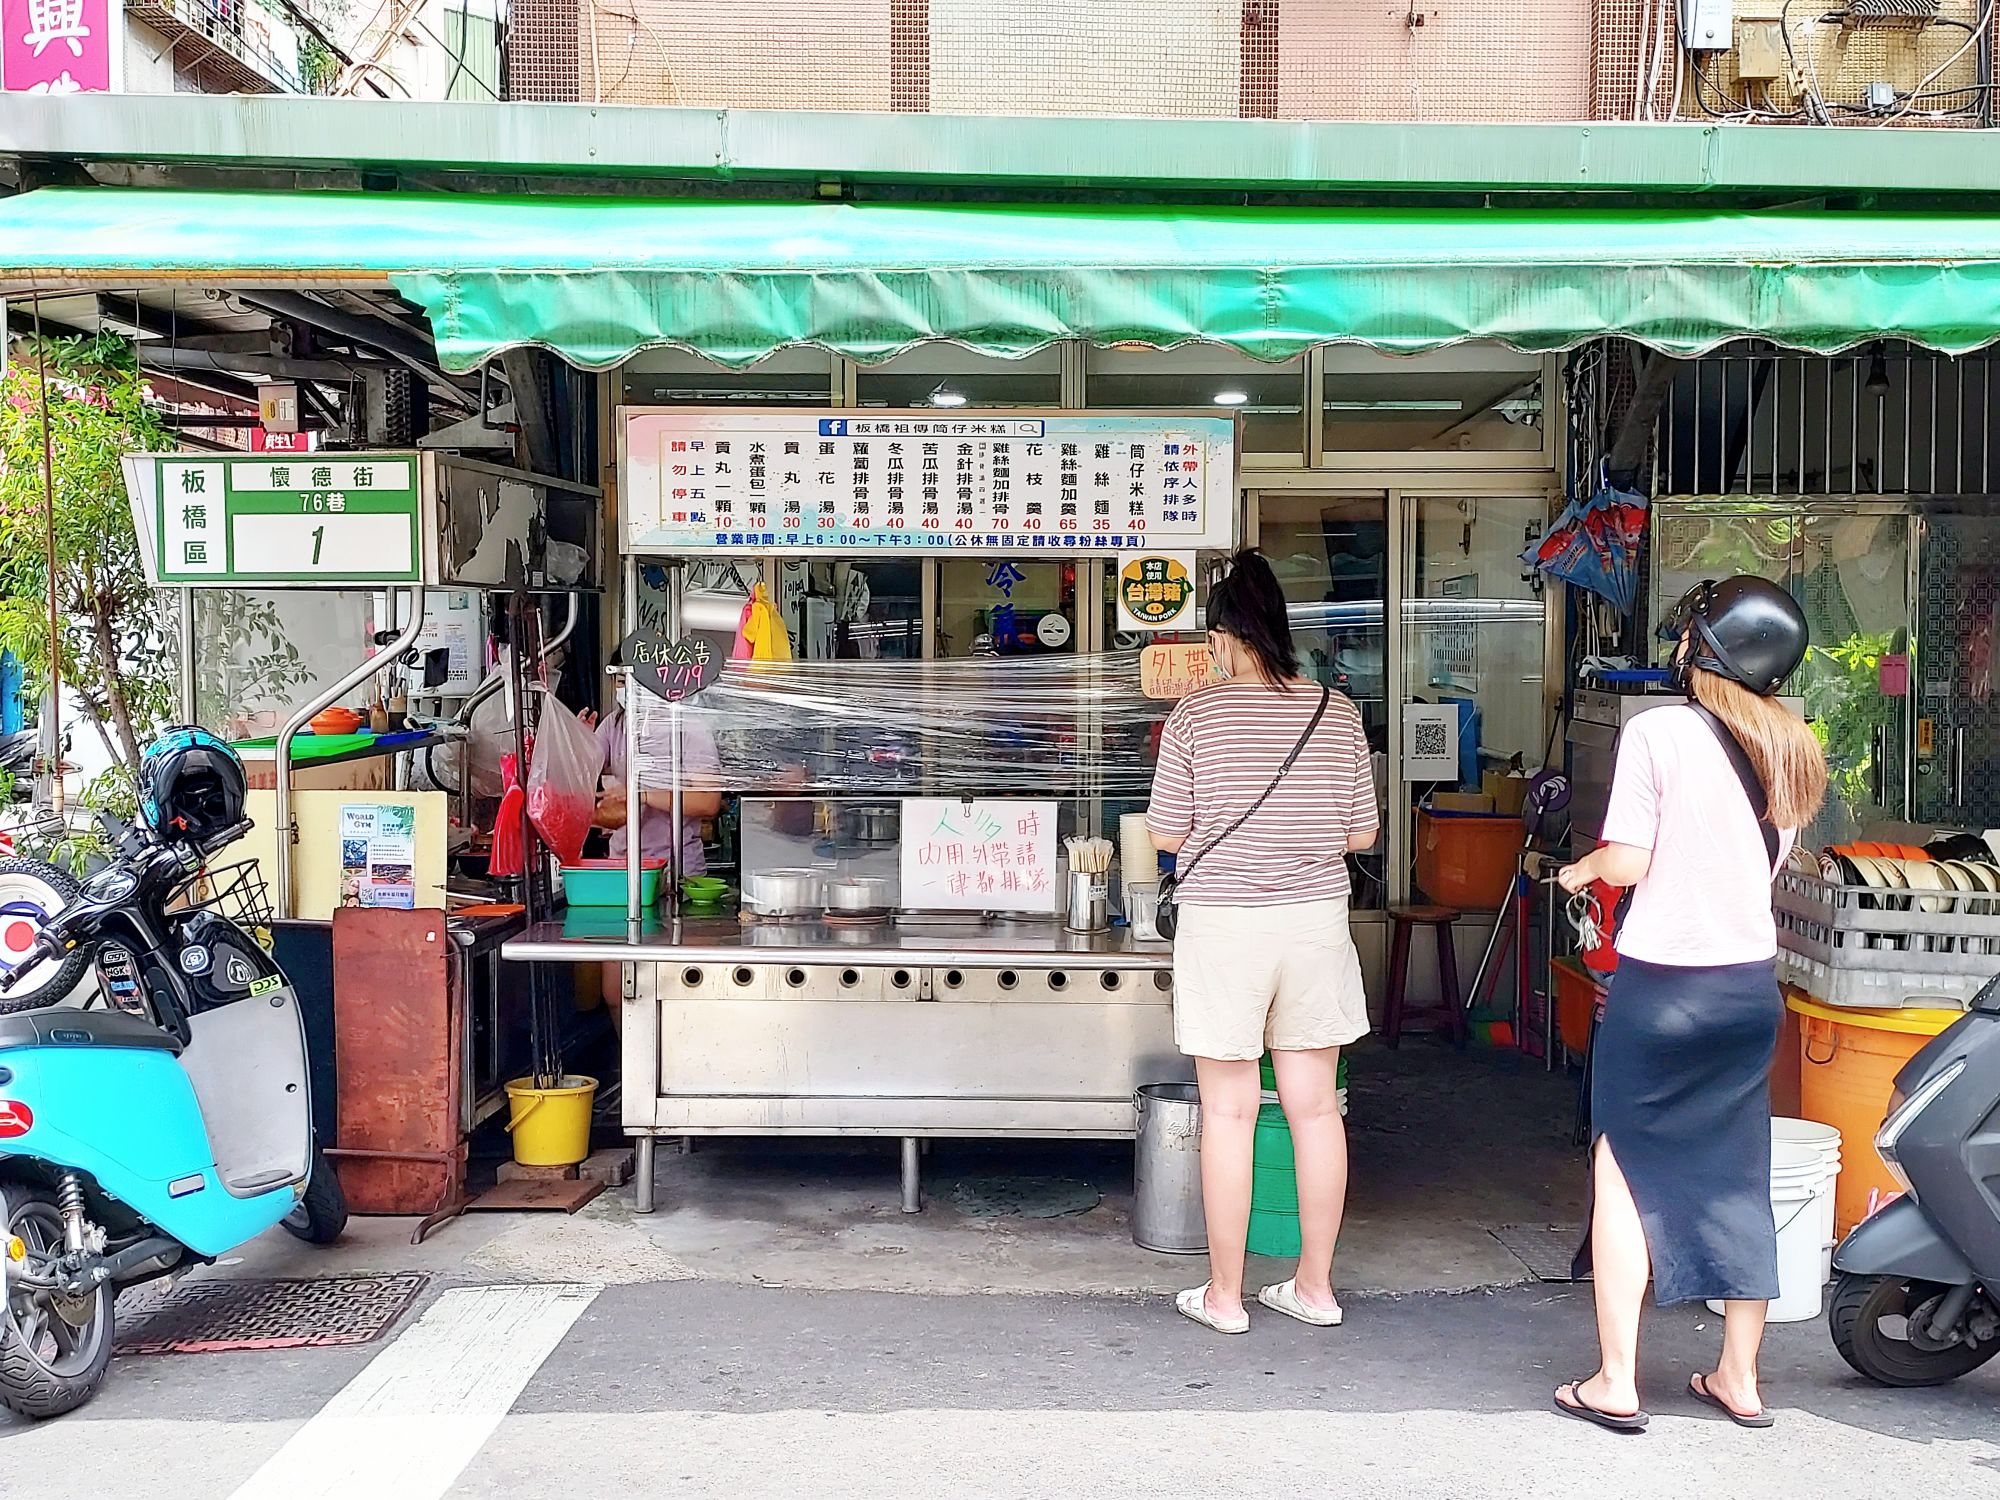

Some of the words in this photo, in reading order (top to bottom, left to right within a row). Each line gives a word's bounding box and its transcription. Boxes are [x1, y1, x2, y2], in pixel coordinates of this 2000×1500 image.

[855, 422, 1006, 434] 板橋祖傳筒仔米糕
[269, 466, 374, 488] 懷德街
[671, 441, 687, 522] 請勿停車
[690, 441, 706, 523] 早上五點
[714, 441, 732, 513] 貢丸一顆
[749, 442, 766, 514] 水煮蛋包一顆
[818, 441, 835, 514] 蛋花湯
[852, 442, 870, 515] 蘿蔔排骨湯
[887, 442, 905, 515] 冬瓜排骨湯
[921, 442, 939, 516] 苦瓜排骨湯
[956, 442, 974, 516] 金針排骨湯
[1025, 443, 1043, 516] 花枝羹
[1094, 443, 1110, 515] 雞絲麵
[1128, 443, 1146, 517] 筒仔米糕
[1163, 443, 1180, 522] 請依序排隊
[1181, 443, 1198, 522] 外帶人多時
[300, 492, 346, 513] 76巷
[181, 469, 207, 565] 板橋區
[714, 516, 732, 528] 10
[748, 516, 766, 528] 10
[783, 517, 801, 528] 30
[817, 517, 835, 528] 30
[852, 517, 870, 529] 40
[886, 517, 904, 529] 40
[921, 518, 940, 530] 40
[955, 518, 973, 530] 40
[991, 518, 1009, 530] 70
[1023, 518, 1041, 530] 40
[1059, 518, 1077, 530] 65
[1092, 518, 1110, 530] 35
[1128, 519, 1146, 531] 40
[311, 525, 325, 565] 1
[1146, 561, 1163, 571] 本店
[1146, 571, 1162, 580] 使用
[1127, 582, 1182, 602] 台灣豬
[1133, 607, 1158, 622] TAIWAN
[1158, 607, 1178, 621] PORK
[632, 639, 711, 666] 店休公告
[655, 664, 704, 687] 7/19
[1152, 648, 1209, 688] 外帶
[930, 807, 1041, 842] 人多時
[922, 868, 1048, 897] 一律都排隊
